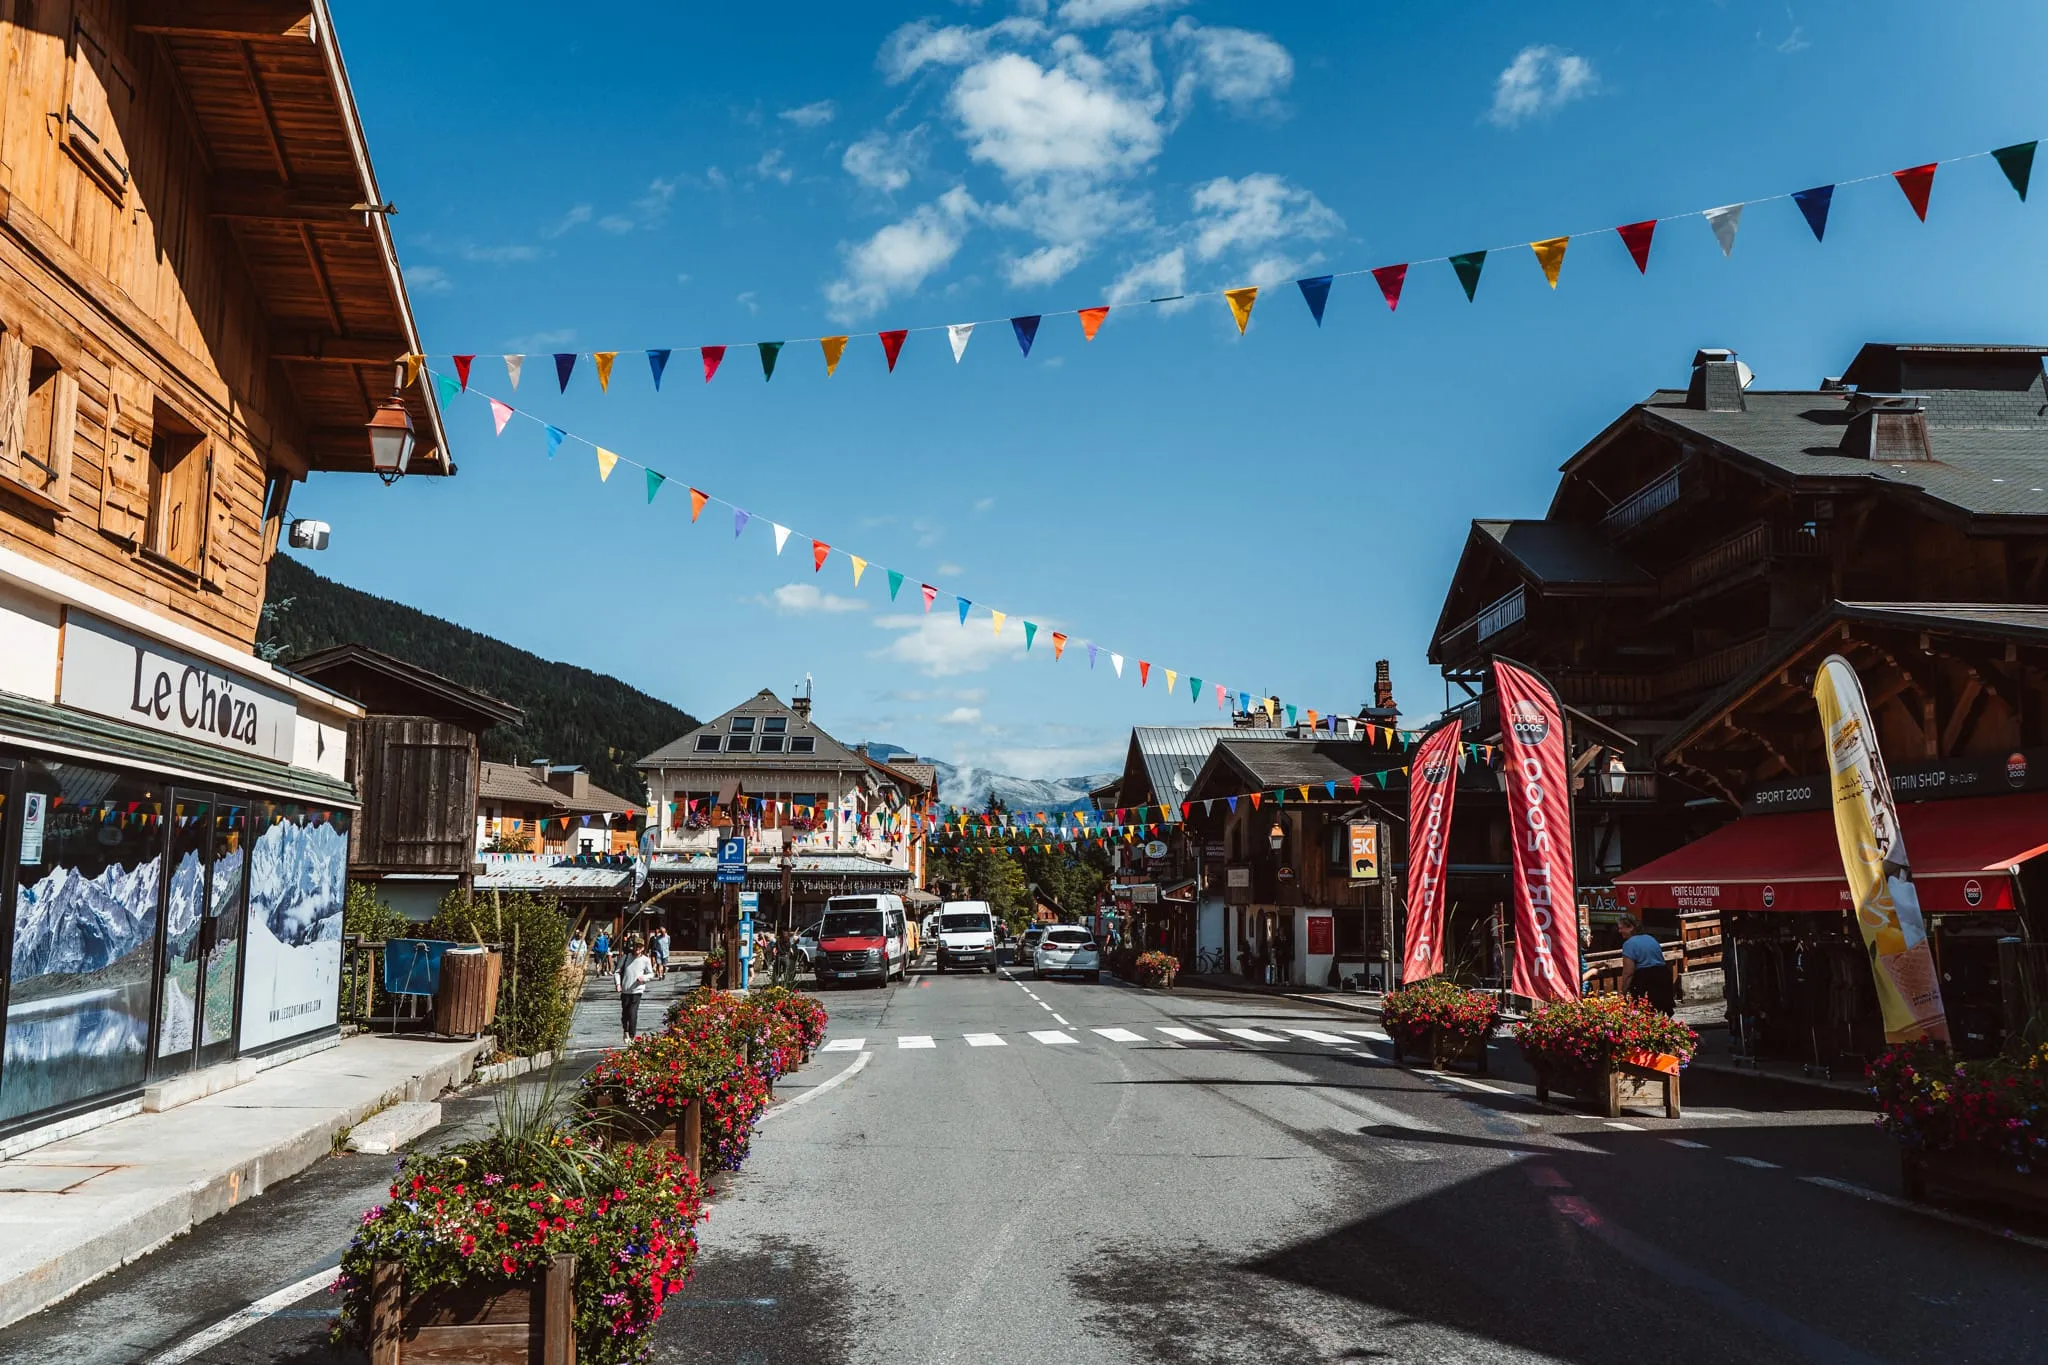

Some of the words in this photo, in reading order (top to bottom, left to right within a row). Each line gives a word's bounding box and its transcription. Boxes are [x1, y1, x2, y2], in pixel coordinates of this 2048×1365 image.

[130, 647, 172, 721] Le
[1918, 771, 1946, 788] SHOP
[1756, 790, 1785, 804] SPORT
[1786, 787, 1812, 801] 2000
[1426, 793, 1444, 866] 2000
[725, 842, 738, 860] P
[1352, 838, 1376, 854] SKI
[1671, 886, 1689, 897] VENTE
[1693, 886, 1720, 897] LOCATION
